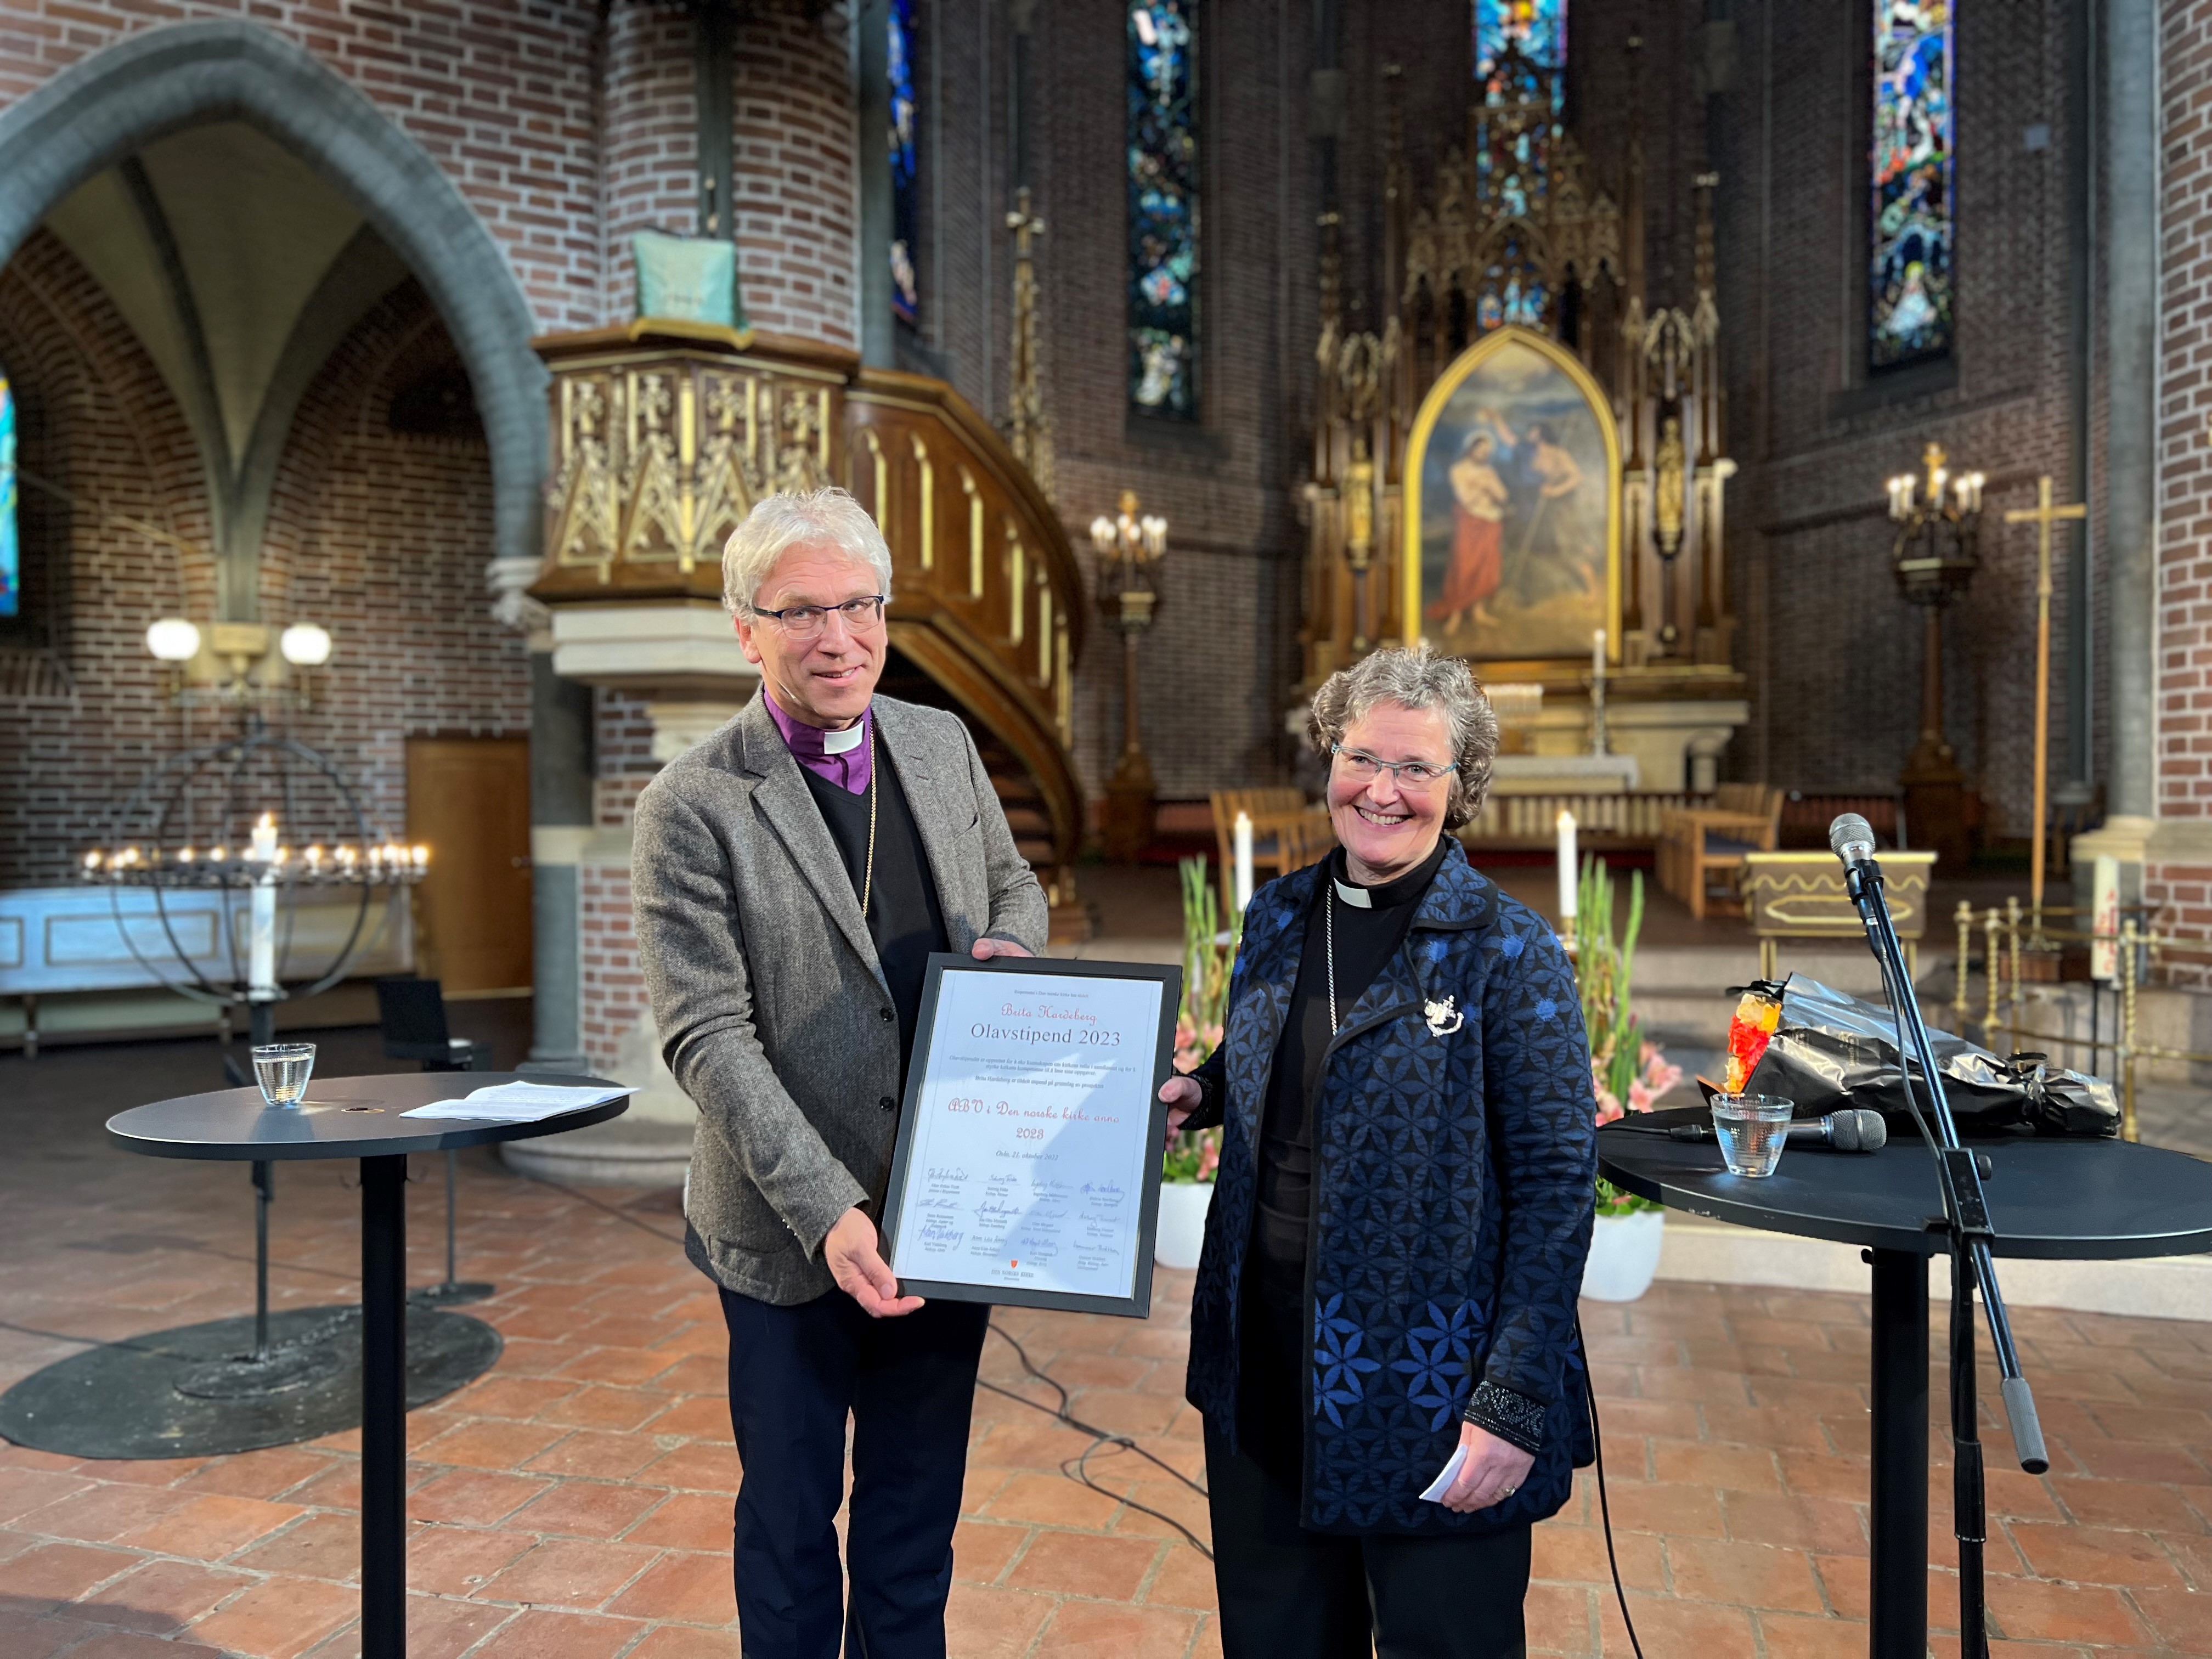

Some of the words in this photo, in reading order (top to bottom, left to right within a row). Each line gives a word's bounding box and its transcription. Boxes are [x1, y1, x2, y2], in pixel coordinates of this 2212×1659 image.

[1001, 1002, 1032, 1018] Brita
[1037, 1005, 1097, 1026] Hardeberg
[971, 1023, 1072, 1045] Olavstipend
[1078, 1030, 1121, 1046] 2023
[986, 1104, 991, 1114] i
[996, 1101, 1020, 1116] Den
[1023, 1105, 1058, 1120] norske
[1062, 1107, 1090, 1122] kirke
[1093, 1114, 1120, 1124] anno
[1015, 1127, 1045, 1140] 2023
